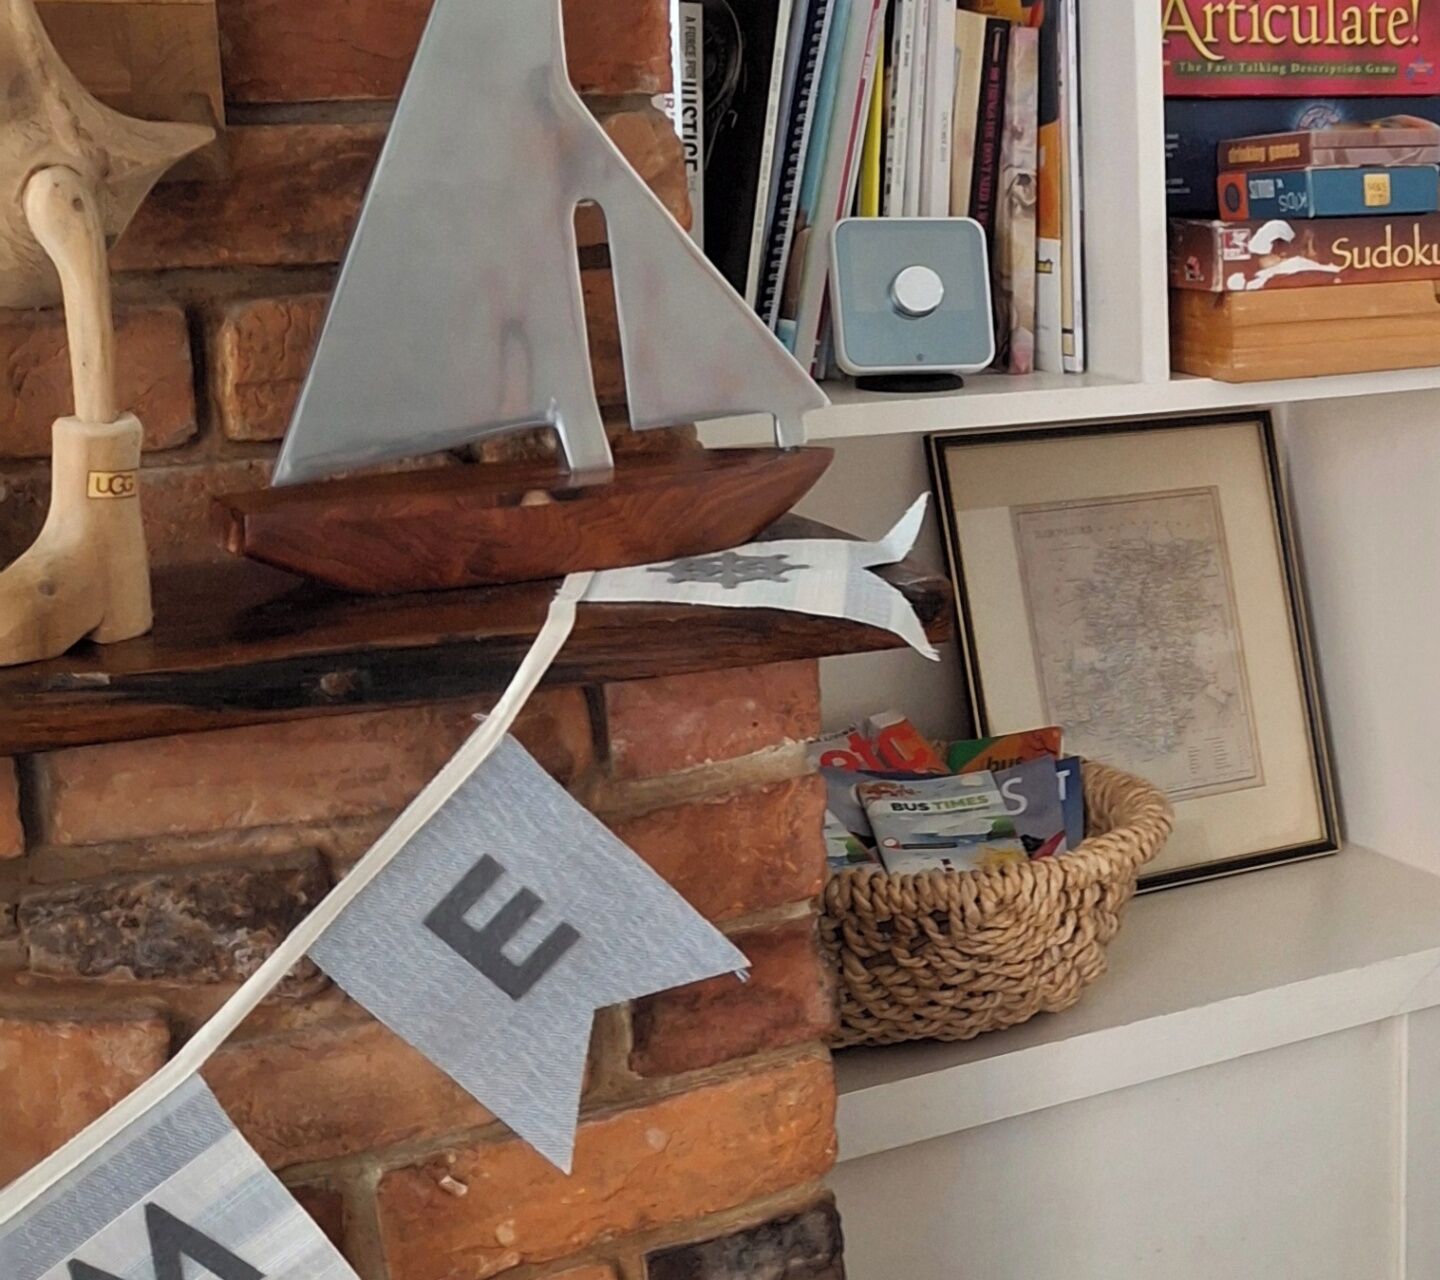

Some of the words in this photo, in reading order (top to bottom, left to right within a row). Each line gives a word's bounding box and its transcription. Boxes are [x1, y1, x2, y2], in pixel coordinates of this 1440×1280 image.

[686, 25, 697, 55] FORCE
[686, 59, 697, 80] FOR
[1179, 61, 1201, 73] The
[1207, 61, 1233, 74] Fast
[1239, 61, 1287, 76] Talking
[1290, 62, 1362, 77] Description
[1365, 63, 1397, 75] Game
[96, 474, 134, 495] UGG
[890, 802, 931, 812] BUS
[934, 794, 989, 810] TIMES
[423, 853, 581, 1001] E
